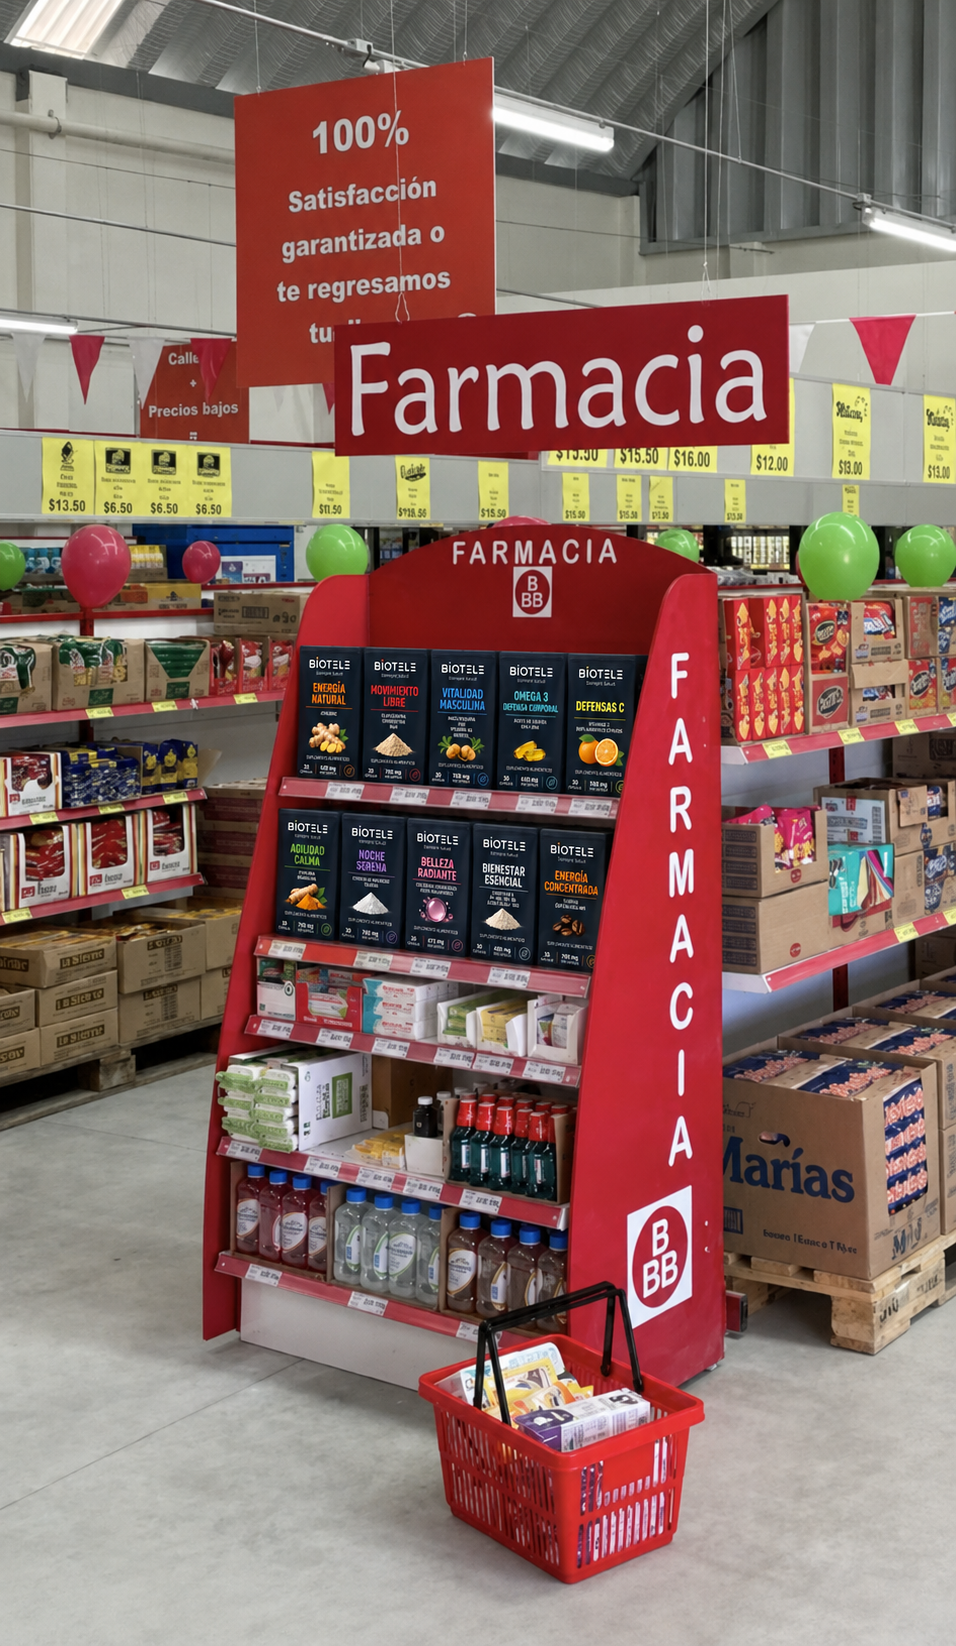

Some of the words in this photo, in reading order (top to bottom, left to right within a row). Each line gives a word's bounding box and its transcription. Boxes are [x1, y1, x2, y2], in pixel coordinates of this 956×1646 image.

[312, 110, 409, 154] 100%
[288, 176, 437, 213] Satisfacción
[281, 224, 422, 264] garantizada
[430, 225, 445, 243] o
[277, 280, 301, 302] te
[308, 271, 451, 303] regresamos
[350, 324, 768, 437] Farmacia
[149, 403, 199, 418] Precios
[203, 401, 239, 416] bajos
[620, 447, 659, 465] $15.50
[674, 449, 711, 468] $16.00
[756, 454, 789, 472] $12.00
[838, 460, 863, 476] $13.00
[928, 465, 951, 480] $13.00
[48, 498, 86, 513] $13.50
[103, 501, 133, 514] $6.50
[150, 502, 178, 515] $6.50
[195, 503, 222, 516] $6.50
[319, 503, 342, 515] $11.50
[452, 538, 617, 565] FARMACIA
[527, 575, 538, 592] B
[521, 592, 543, 608] BB
[442, 687, 484, 700] VITALIDAD
[514, 690, 541, 702] OMEGA
[543, 691, 549, 703] 3
[383, 697, 406, 708] LIBRE
[440, 699, 486, 711] MASCULINA
[576, 701, 617, 713] DEFENSAS
[619, 702, 625, 713] C
[294, 854, 320, 867] CALMA
[358, 849, 385, 862] NOCHE
[421, 856, 454, 869] BELLEZA
[417, 867, 457, 882] RADIANTE
[482, 862, 526, 877] BIENESTAR
[484, 874, 523, 888] ESENCIAL
[544, 881, 599, 896] CONCENTRADA
[668, 652, 695, 1168] FARMACIA
[651, 1218, 670, 1258] B
[642, 1250, 679, 1299] BB
